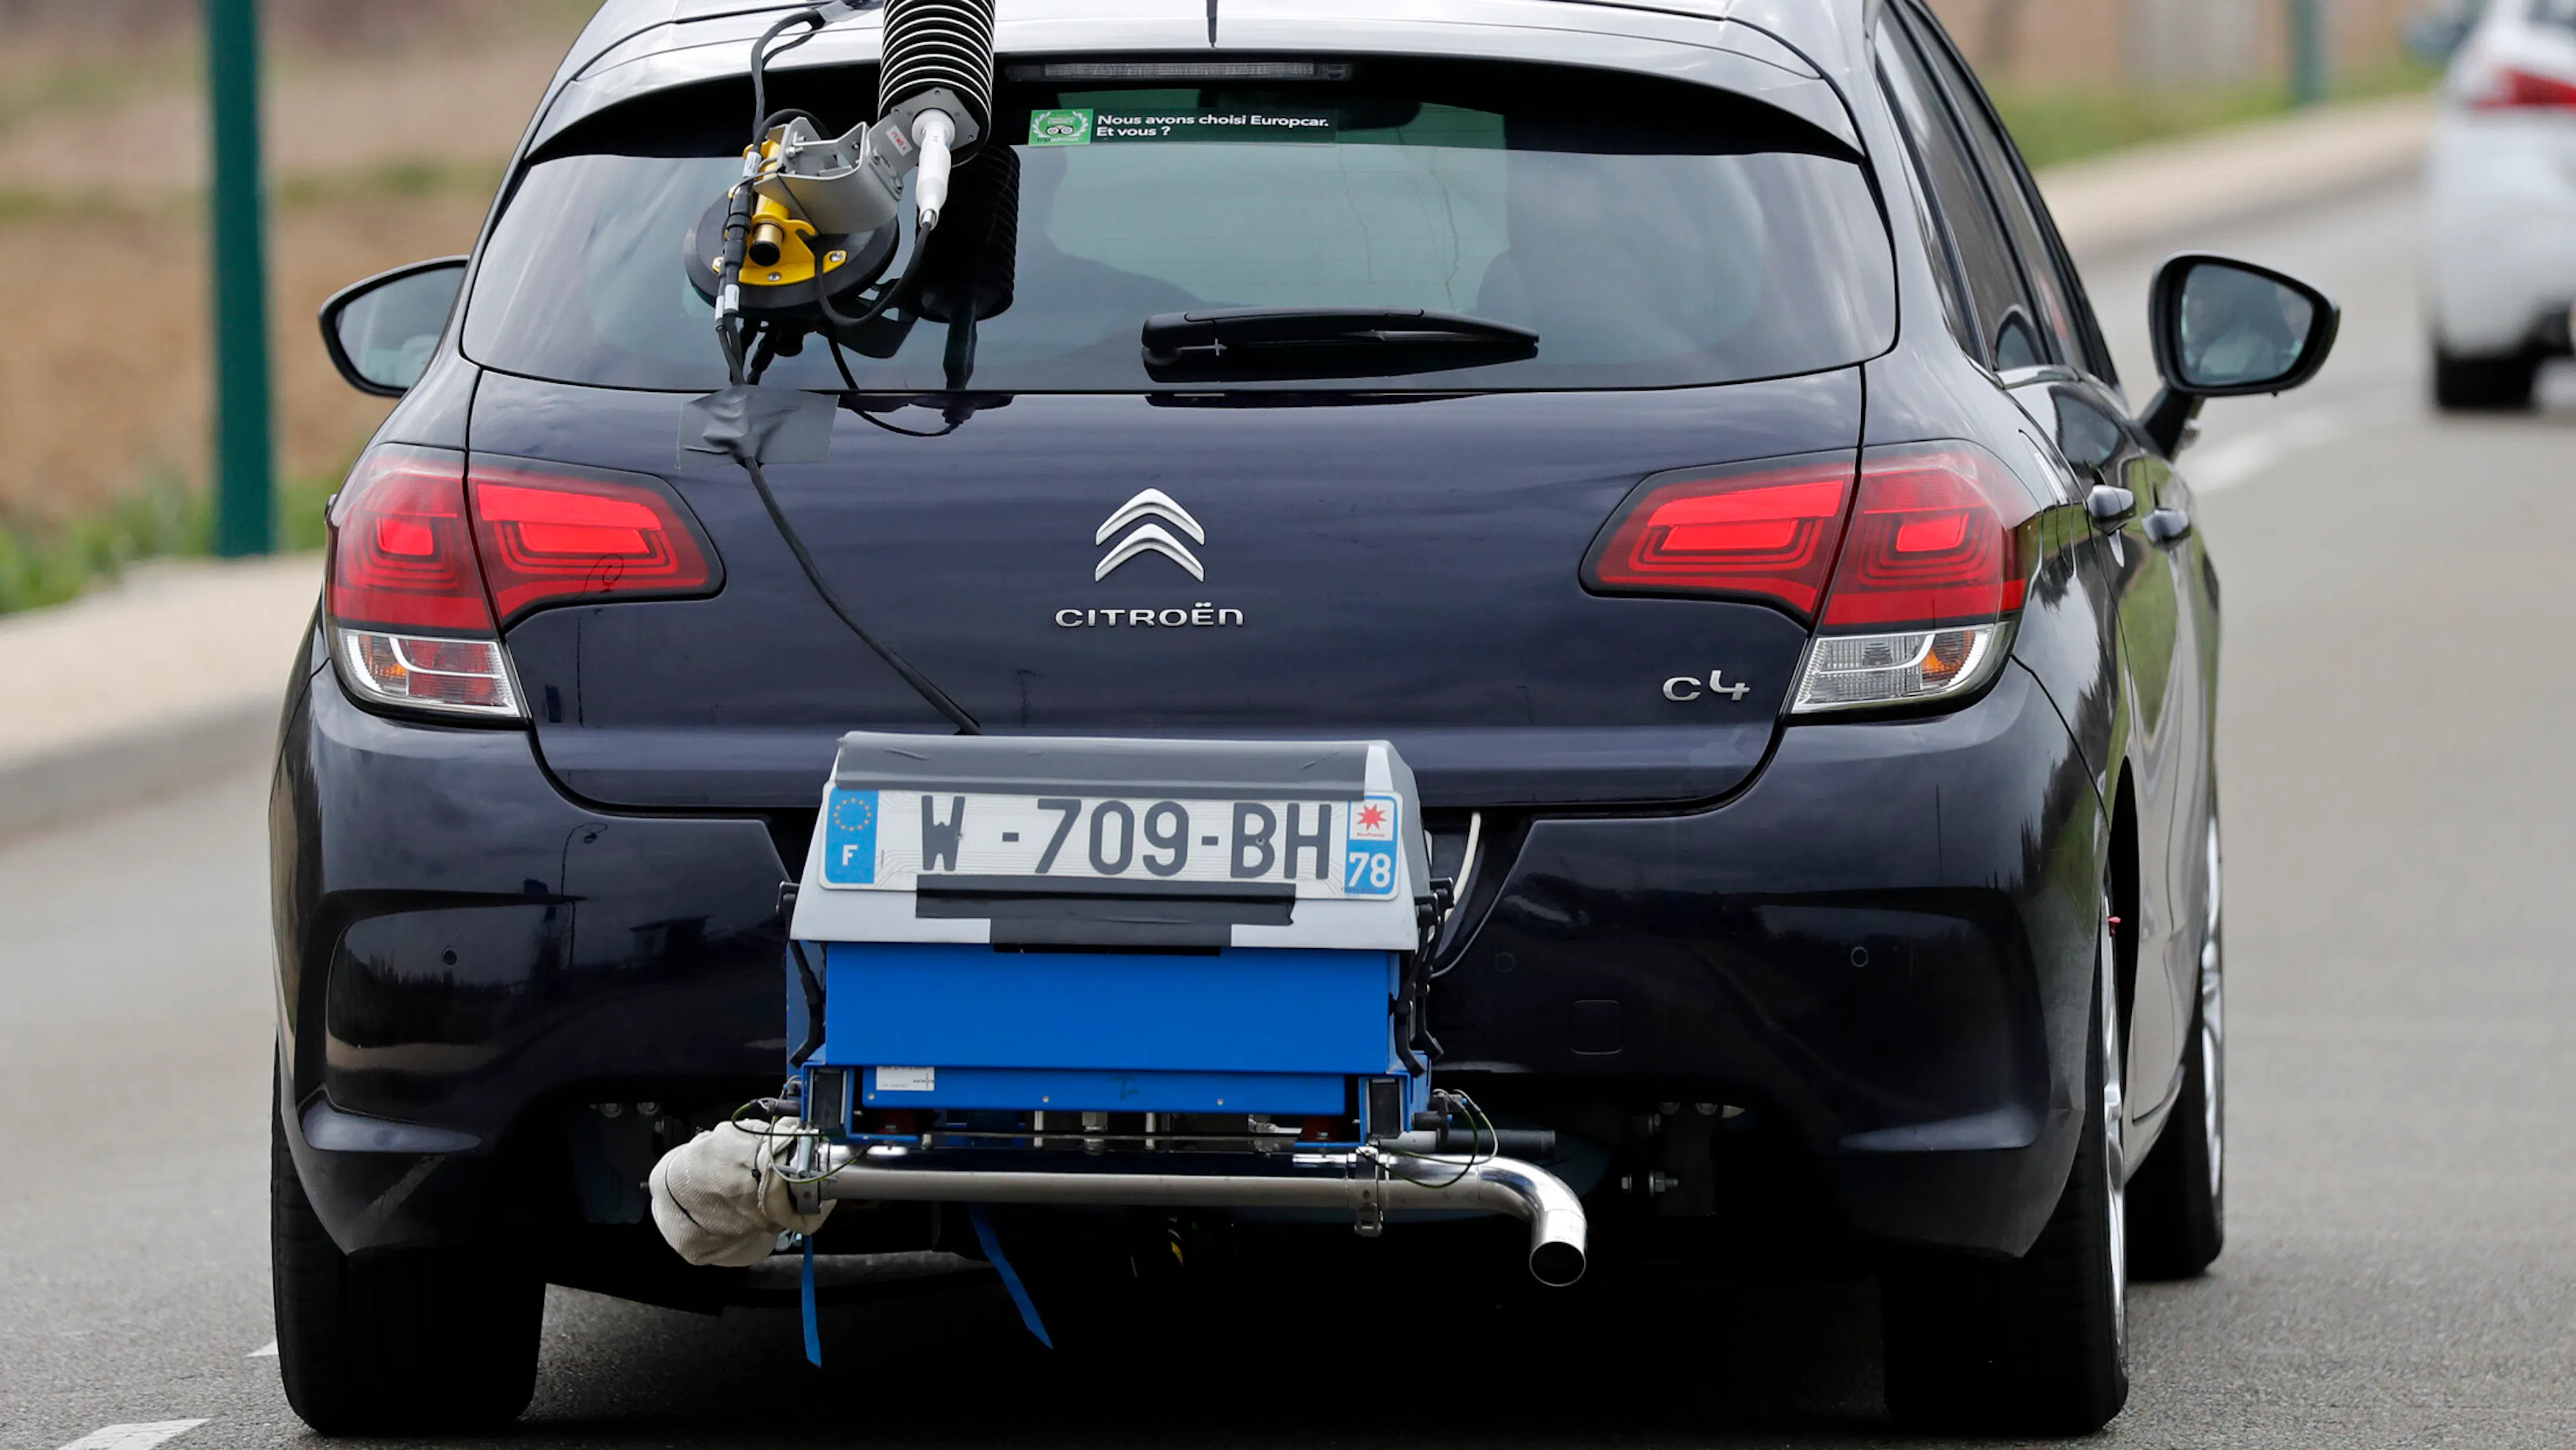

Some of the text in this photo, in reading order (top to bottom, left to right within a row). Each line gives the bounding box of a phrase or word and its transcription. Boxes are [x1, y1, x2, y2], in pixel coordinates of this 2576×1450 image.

[1096, 126, 1171, 137] Et vous ?
[1097, 114, 1329, 129] Nous avons choisi Europcar.
[1055, 602, 1244, 627] CITROËN
[1662, 670, 1750, 701] C4
[842, 844, 859, 866] F
[1348, 852, 1391, 888] 78
